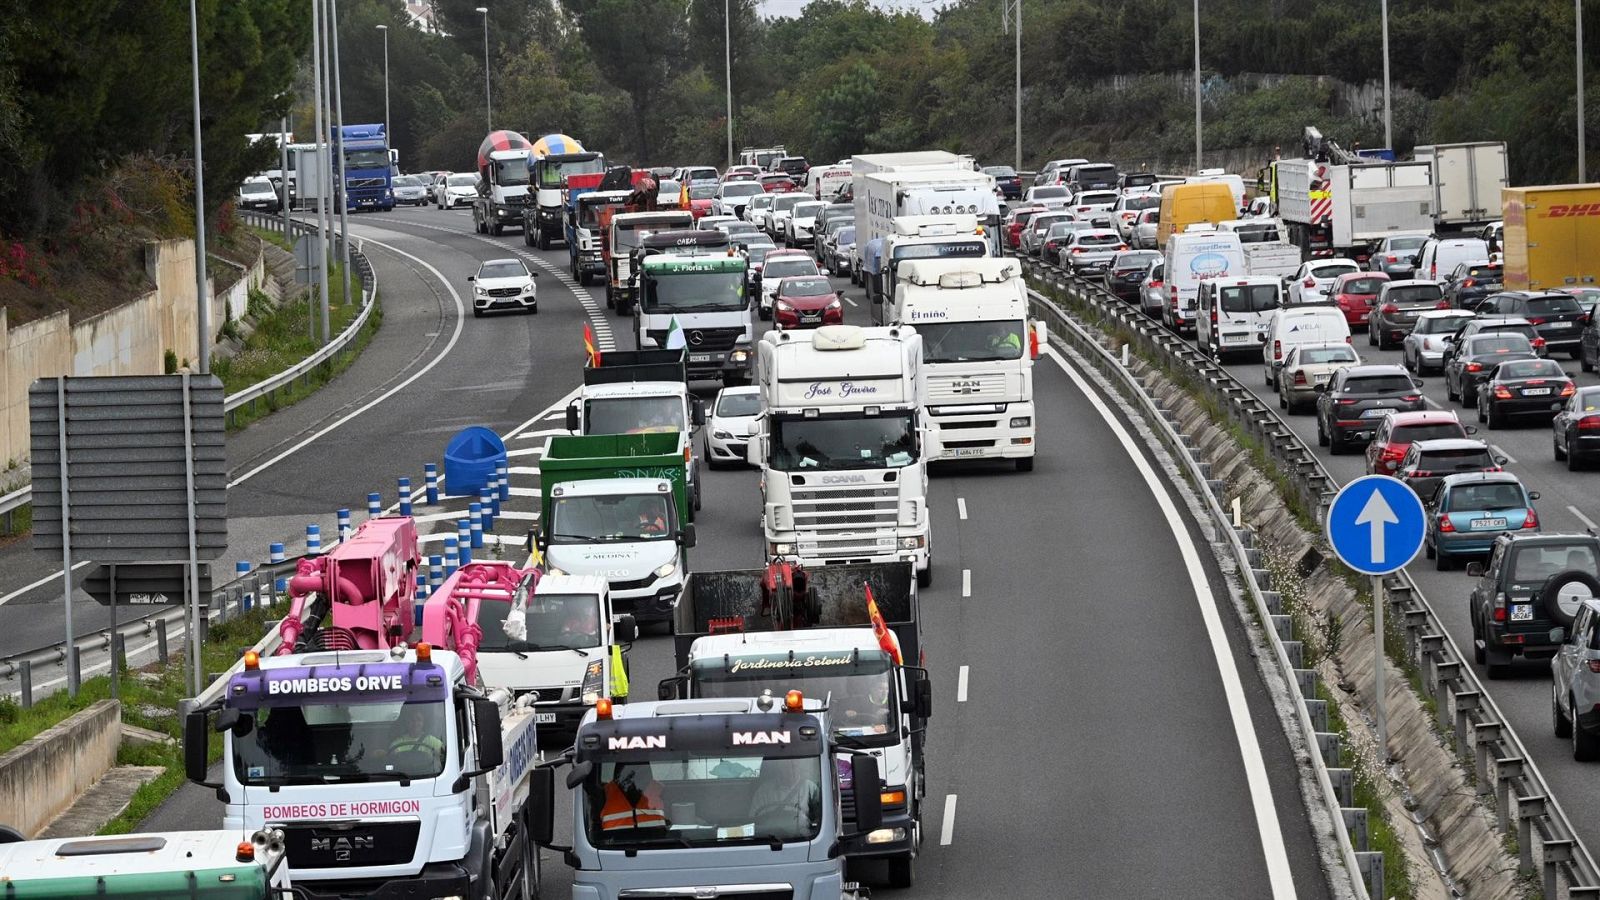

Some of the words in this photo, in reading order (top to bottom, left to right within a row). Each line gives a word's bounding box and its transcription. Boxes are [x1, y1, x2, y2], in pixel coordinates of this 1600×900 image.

[822, 474, 866, 484] SCANIA
[594, 568, 630, 578] IVECO
[269, 677, 352, 695] BOMBEOS
[355, 675, 403, 691] ORVE
[608, 735, 667, 750] MAN
[732, 731, 791, 746] MAN
[263, 804, 328, 819] BOMBEOS
[330, 802, 348, 816] DE
[350, 800, 421, 816] HORMIGON
[311, 835, 375, 851] MAN
